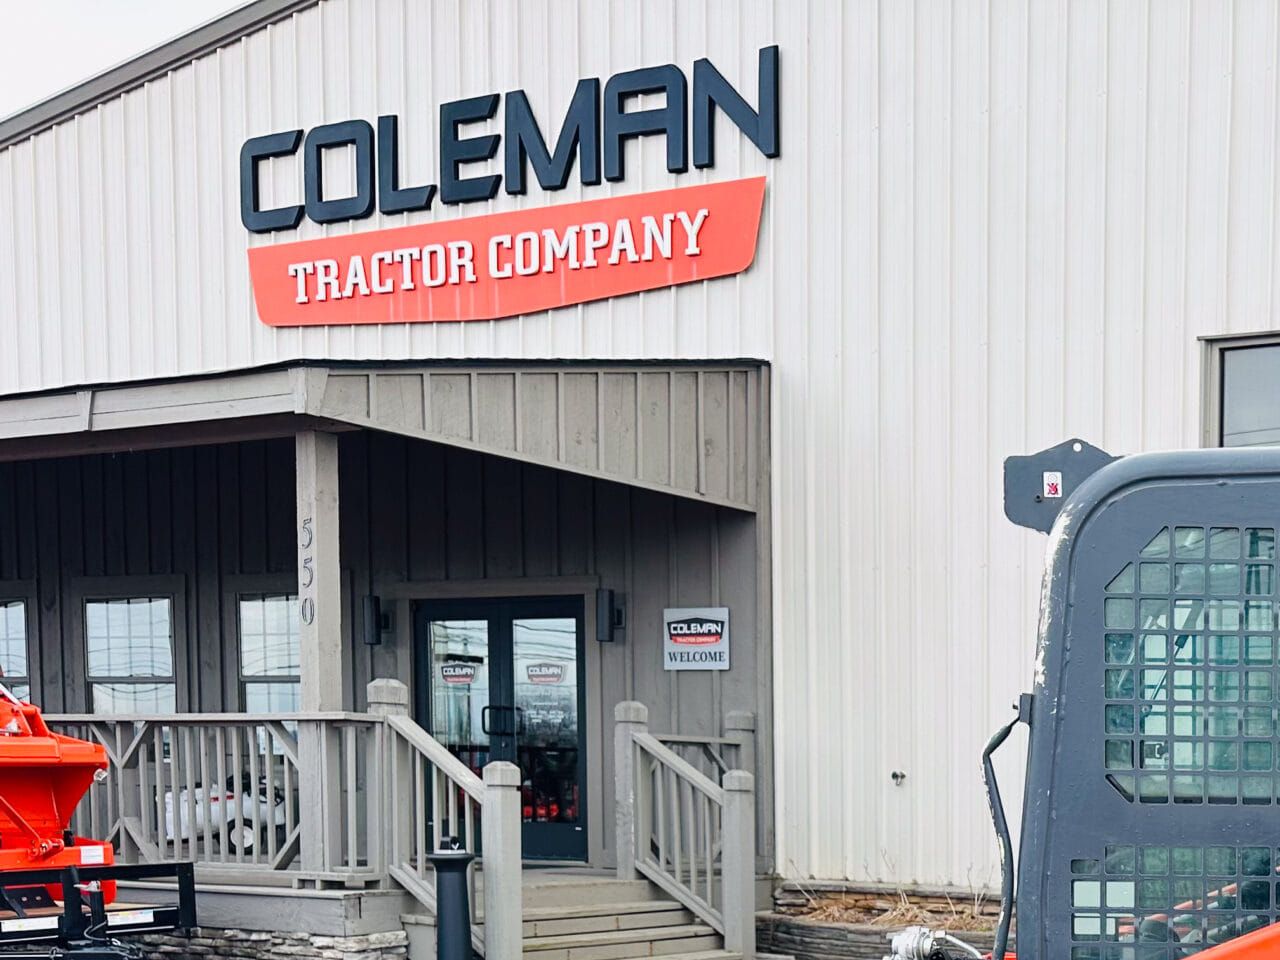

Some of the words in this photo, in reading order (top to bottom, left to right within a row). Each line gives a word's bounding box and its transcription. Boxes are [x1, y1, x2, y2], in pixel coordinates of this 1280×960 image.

[240, 45, 779, 233] COLEMAN
[289, 239, 477, 304] TRACTOR
[488, 208, 709, 280] COMPANY
[670, 622, 722, 634] COLEMAN
[668, 651, 725, 663] WELCOME
